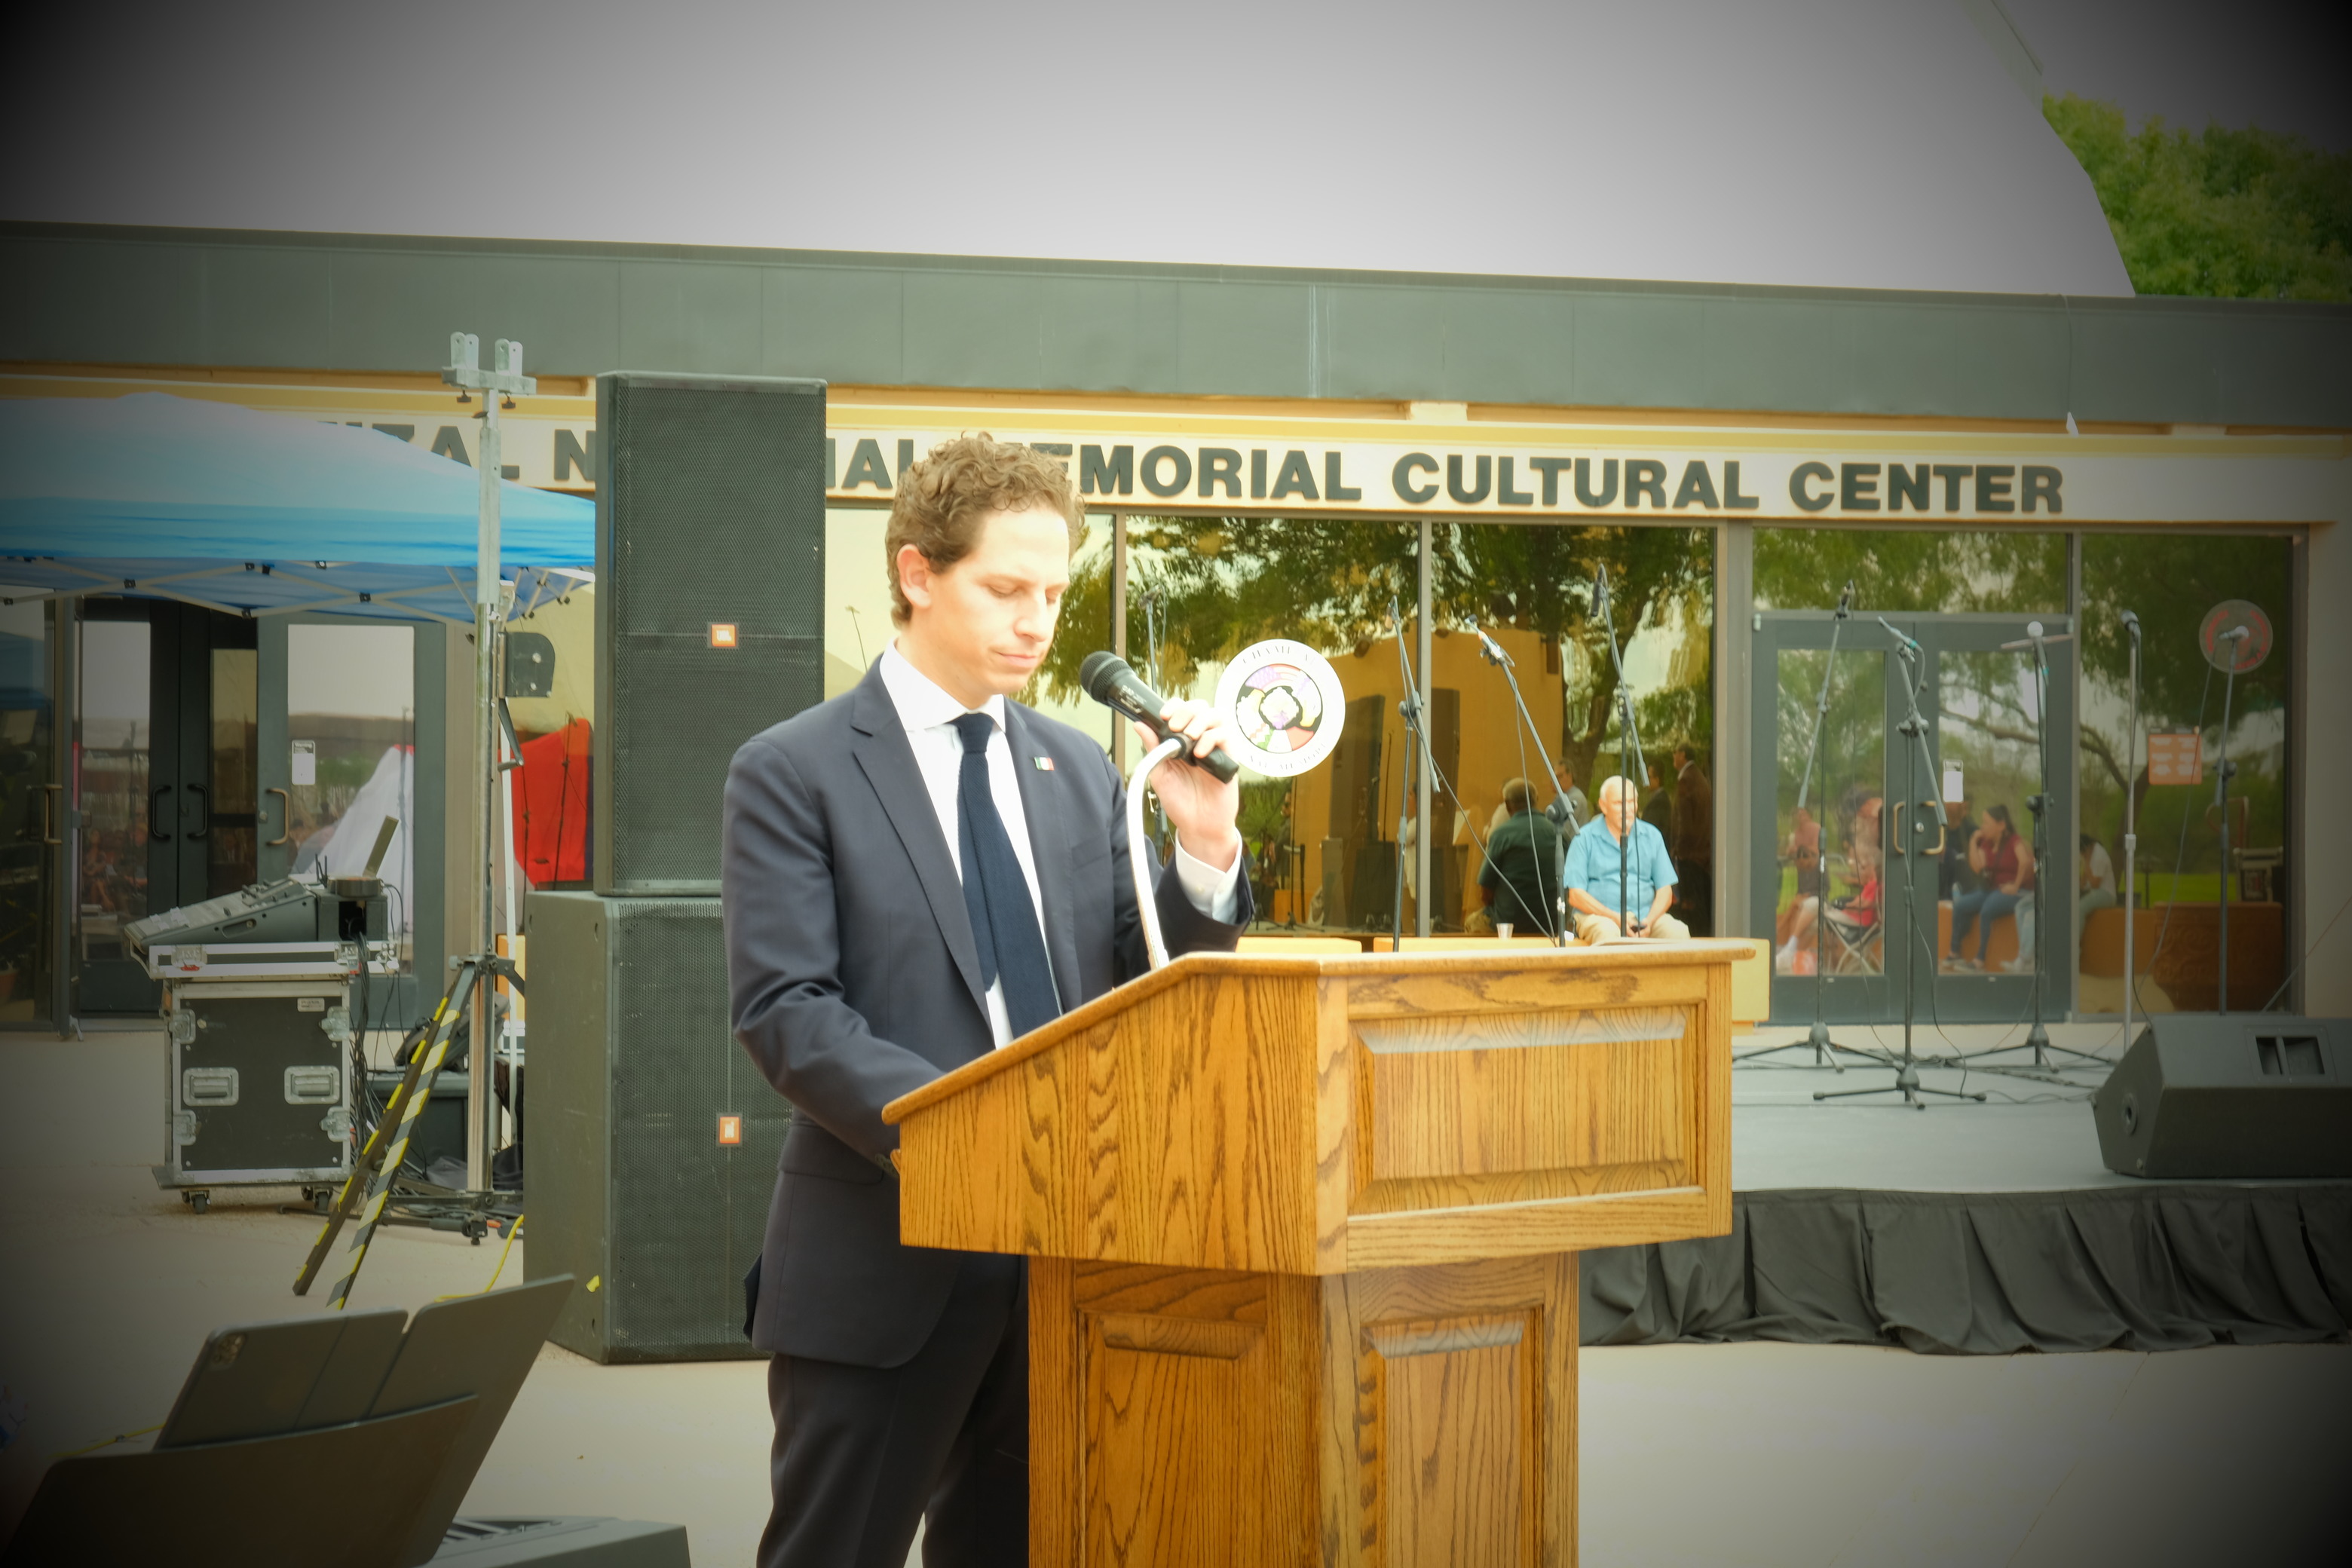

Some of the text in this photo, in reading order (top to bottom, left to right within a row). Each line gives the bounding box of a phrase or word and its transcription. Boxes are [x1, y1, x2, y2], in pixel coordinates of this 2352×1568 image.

[1006, 443, 2063, 513] MORIAL CULTURAL CENTER
